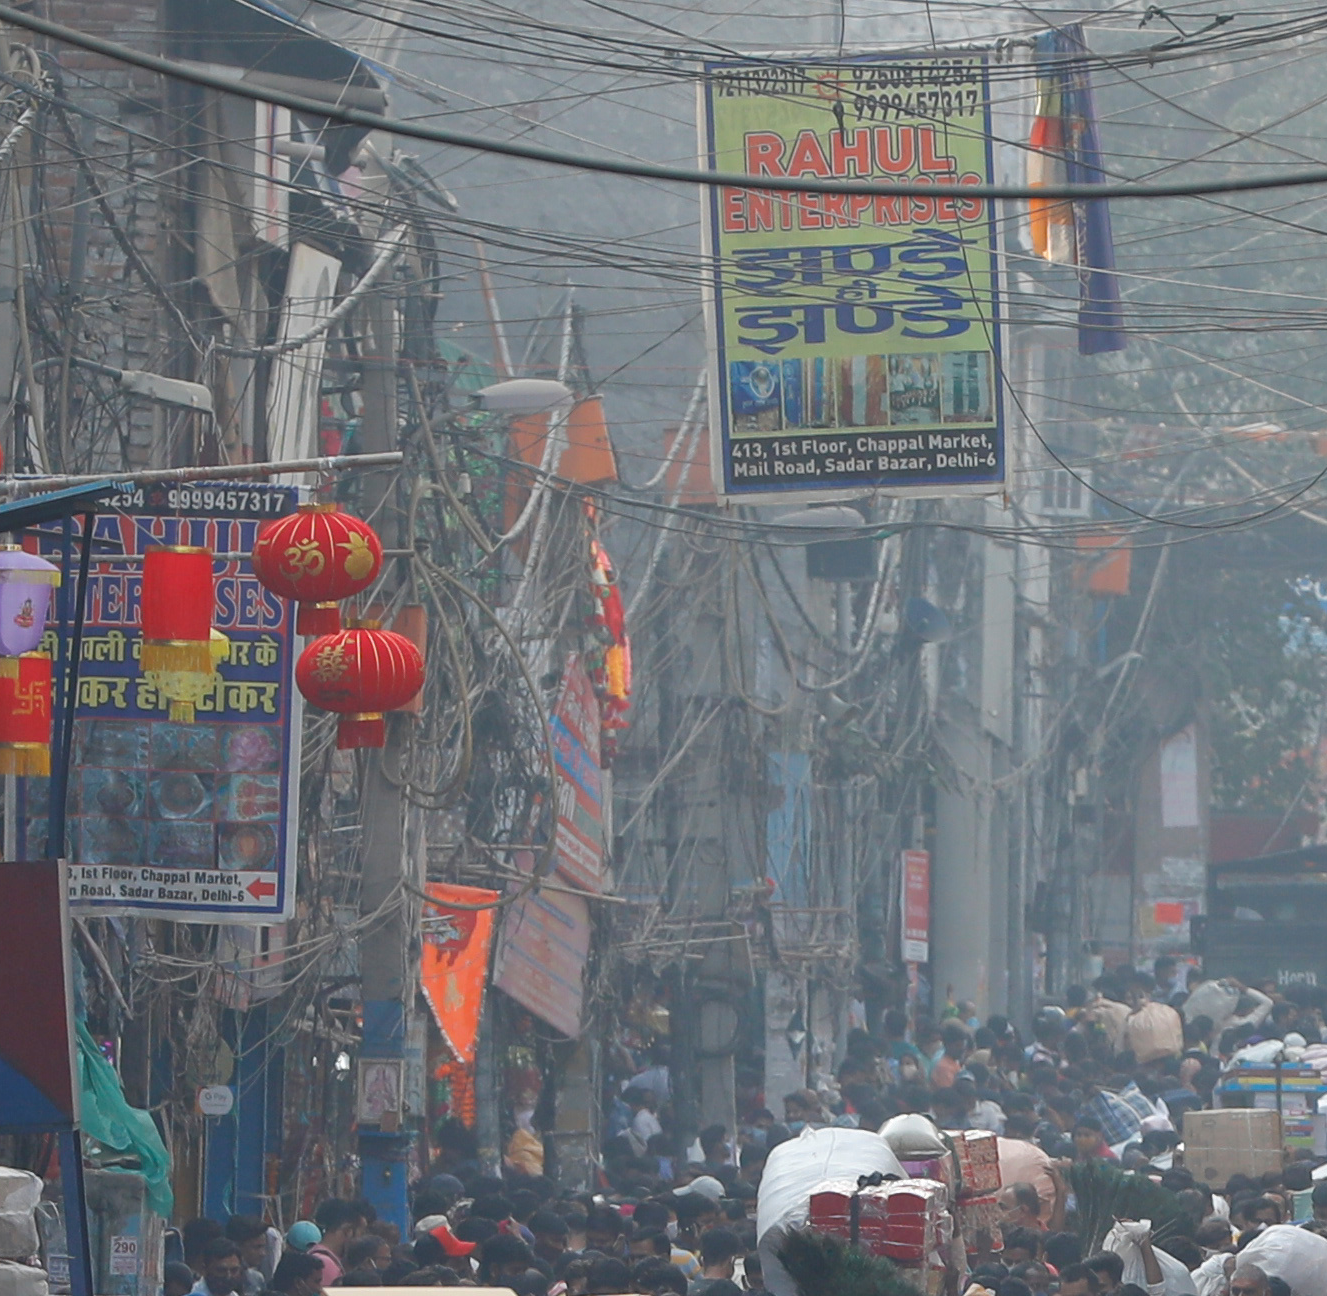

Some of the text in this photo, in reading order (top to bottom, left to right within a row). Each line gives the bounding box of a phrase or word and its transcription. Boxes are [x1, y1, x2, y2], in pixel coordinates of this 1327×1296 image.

[854, 90, 978, 121] 9999457317
[744, 124, 957, 180] RAHUL
[722, 172, 984, 233] ENTERPRISES
[732, 433, 993, 460] 413, 1st Floor, Chappal Market,
[734, 452, 996, 477] Mail Road, Sadar Bazar, Delhi-6
[168, 489, 285, 513] 9999457317
[102, 867, 137, 882] Floor,
[141, 869, 191, 886] Chappal
[195, 870, 242, 887] Market,
[81, 884, 116, 898] Road,
[120, 885, 154, 899] Sadar
[158, 887, 198, 902] Bazar,
[202, 889, 245, 902] Delhi-6
[1278, 969, 1318, 986] Horn
[113, 1241, 136, 1253] 290
